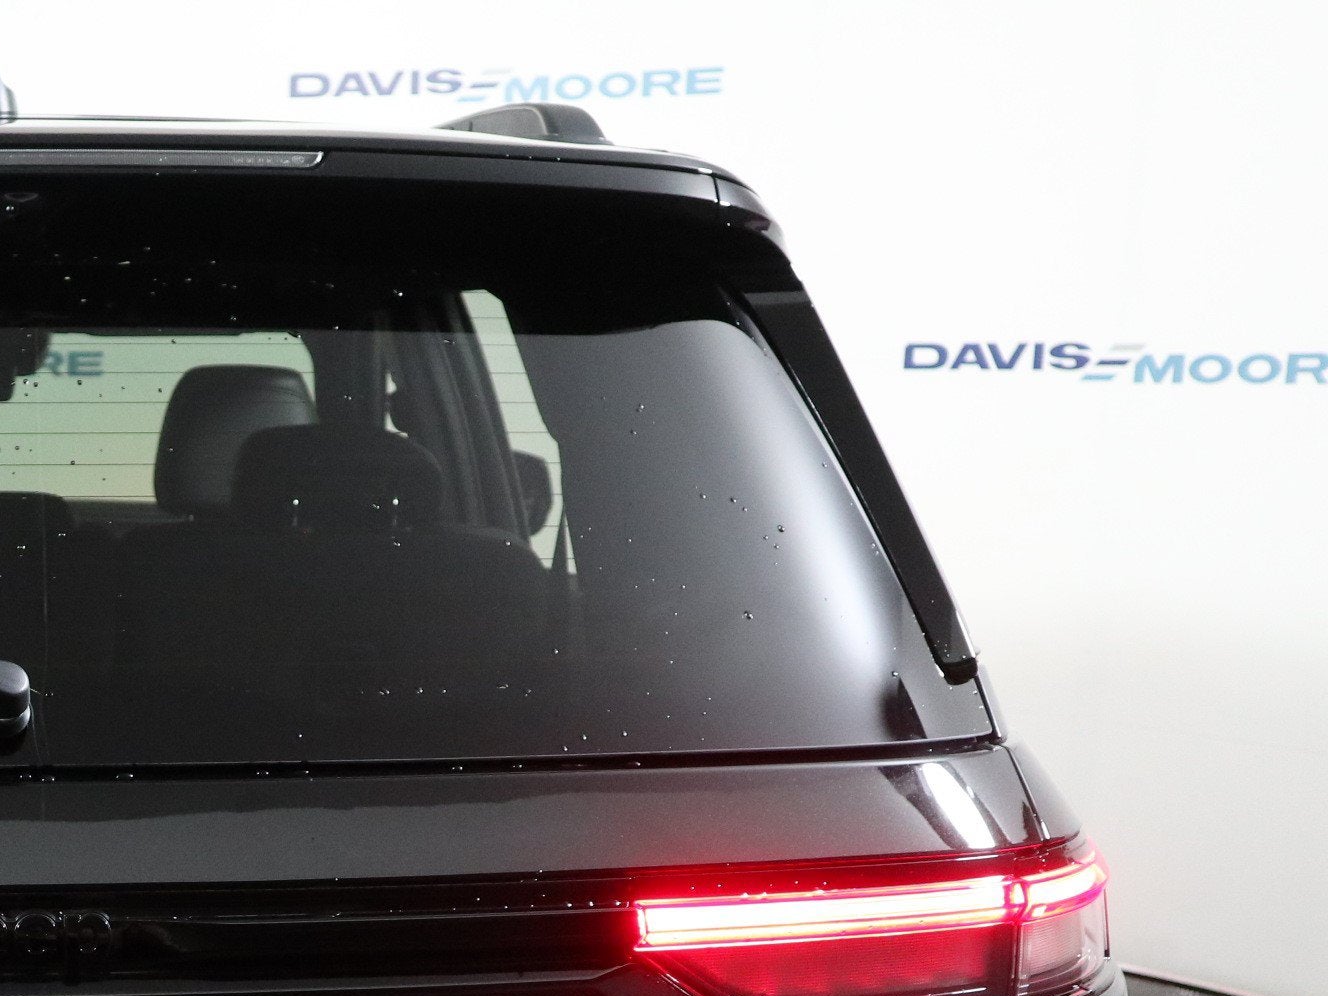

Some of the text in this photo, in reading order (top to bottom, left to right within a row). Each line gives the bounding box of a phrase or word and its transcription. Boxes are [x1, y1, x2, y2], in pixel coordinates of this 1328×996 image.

[288, 67, 725, 103] DAVIS MOORE
[903, 342, 1090, 370] DAVIS
